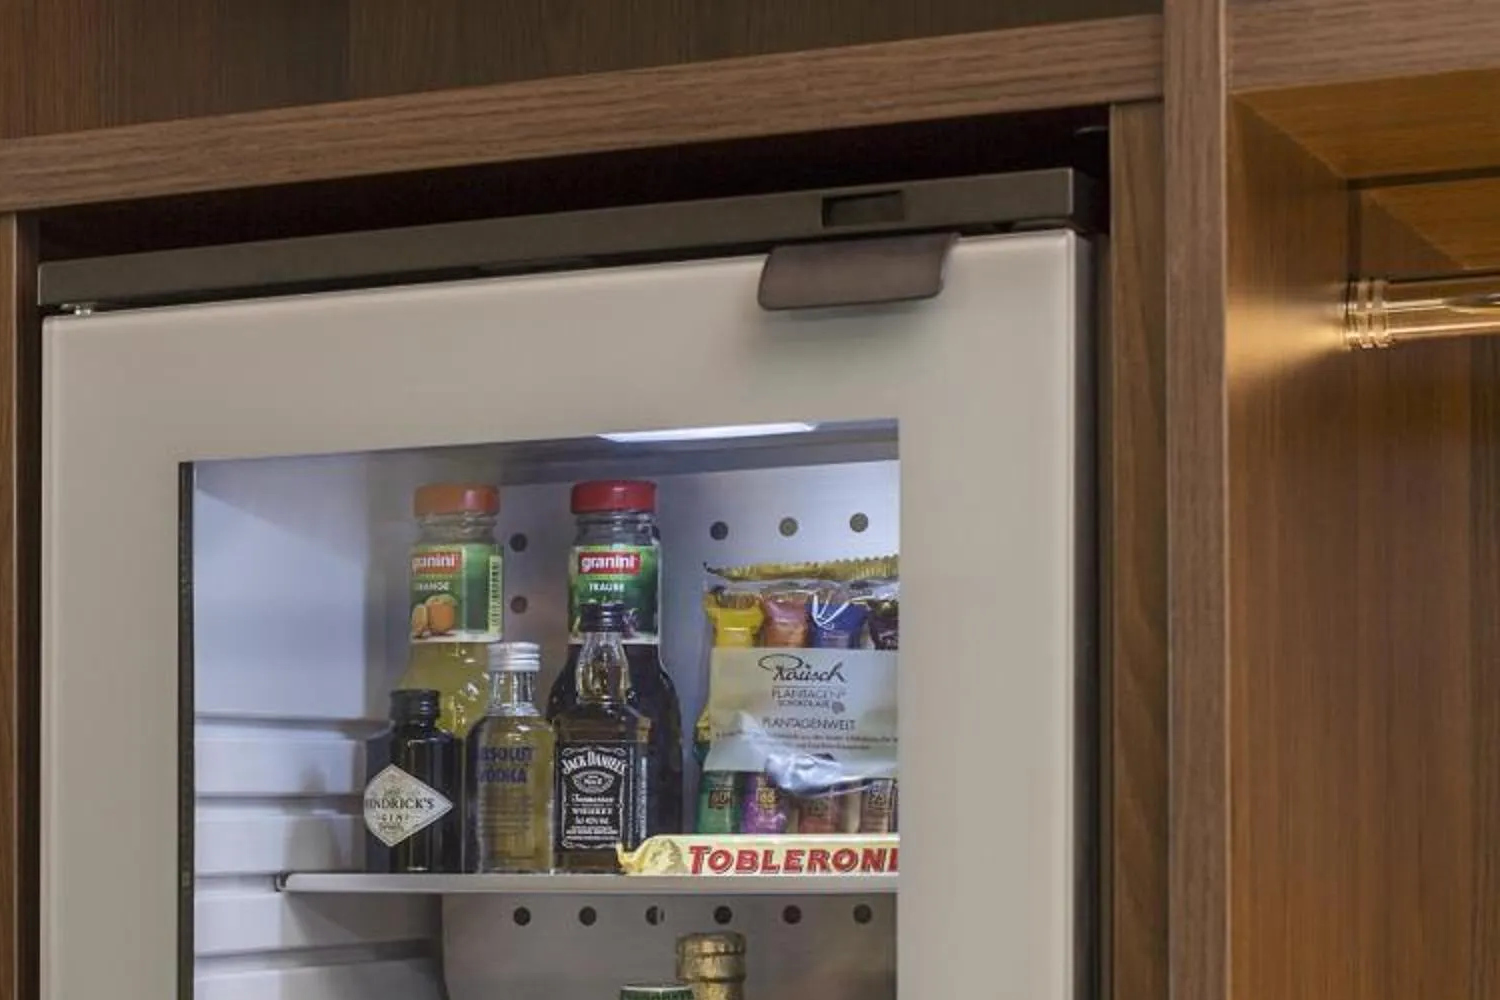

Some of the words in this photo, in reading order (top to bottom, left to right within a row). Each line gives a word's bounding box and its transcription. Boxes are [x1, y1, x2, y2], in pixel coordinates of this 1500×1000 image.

[581, 554, 637, 573] granini
[589, 582, 624, 592] TRAUBE
[562, 755, 587, 774] JACK
[366, 797, 434, 809] NDRICK'S
